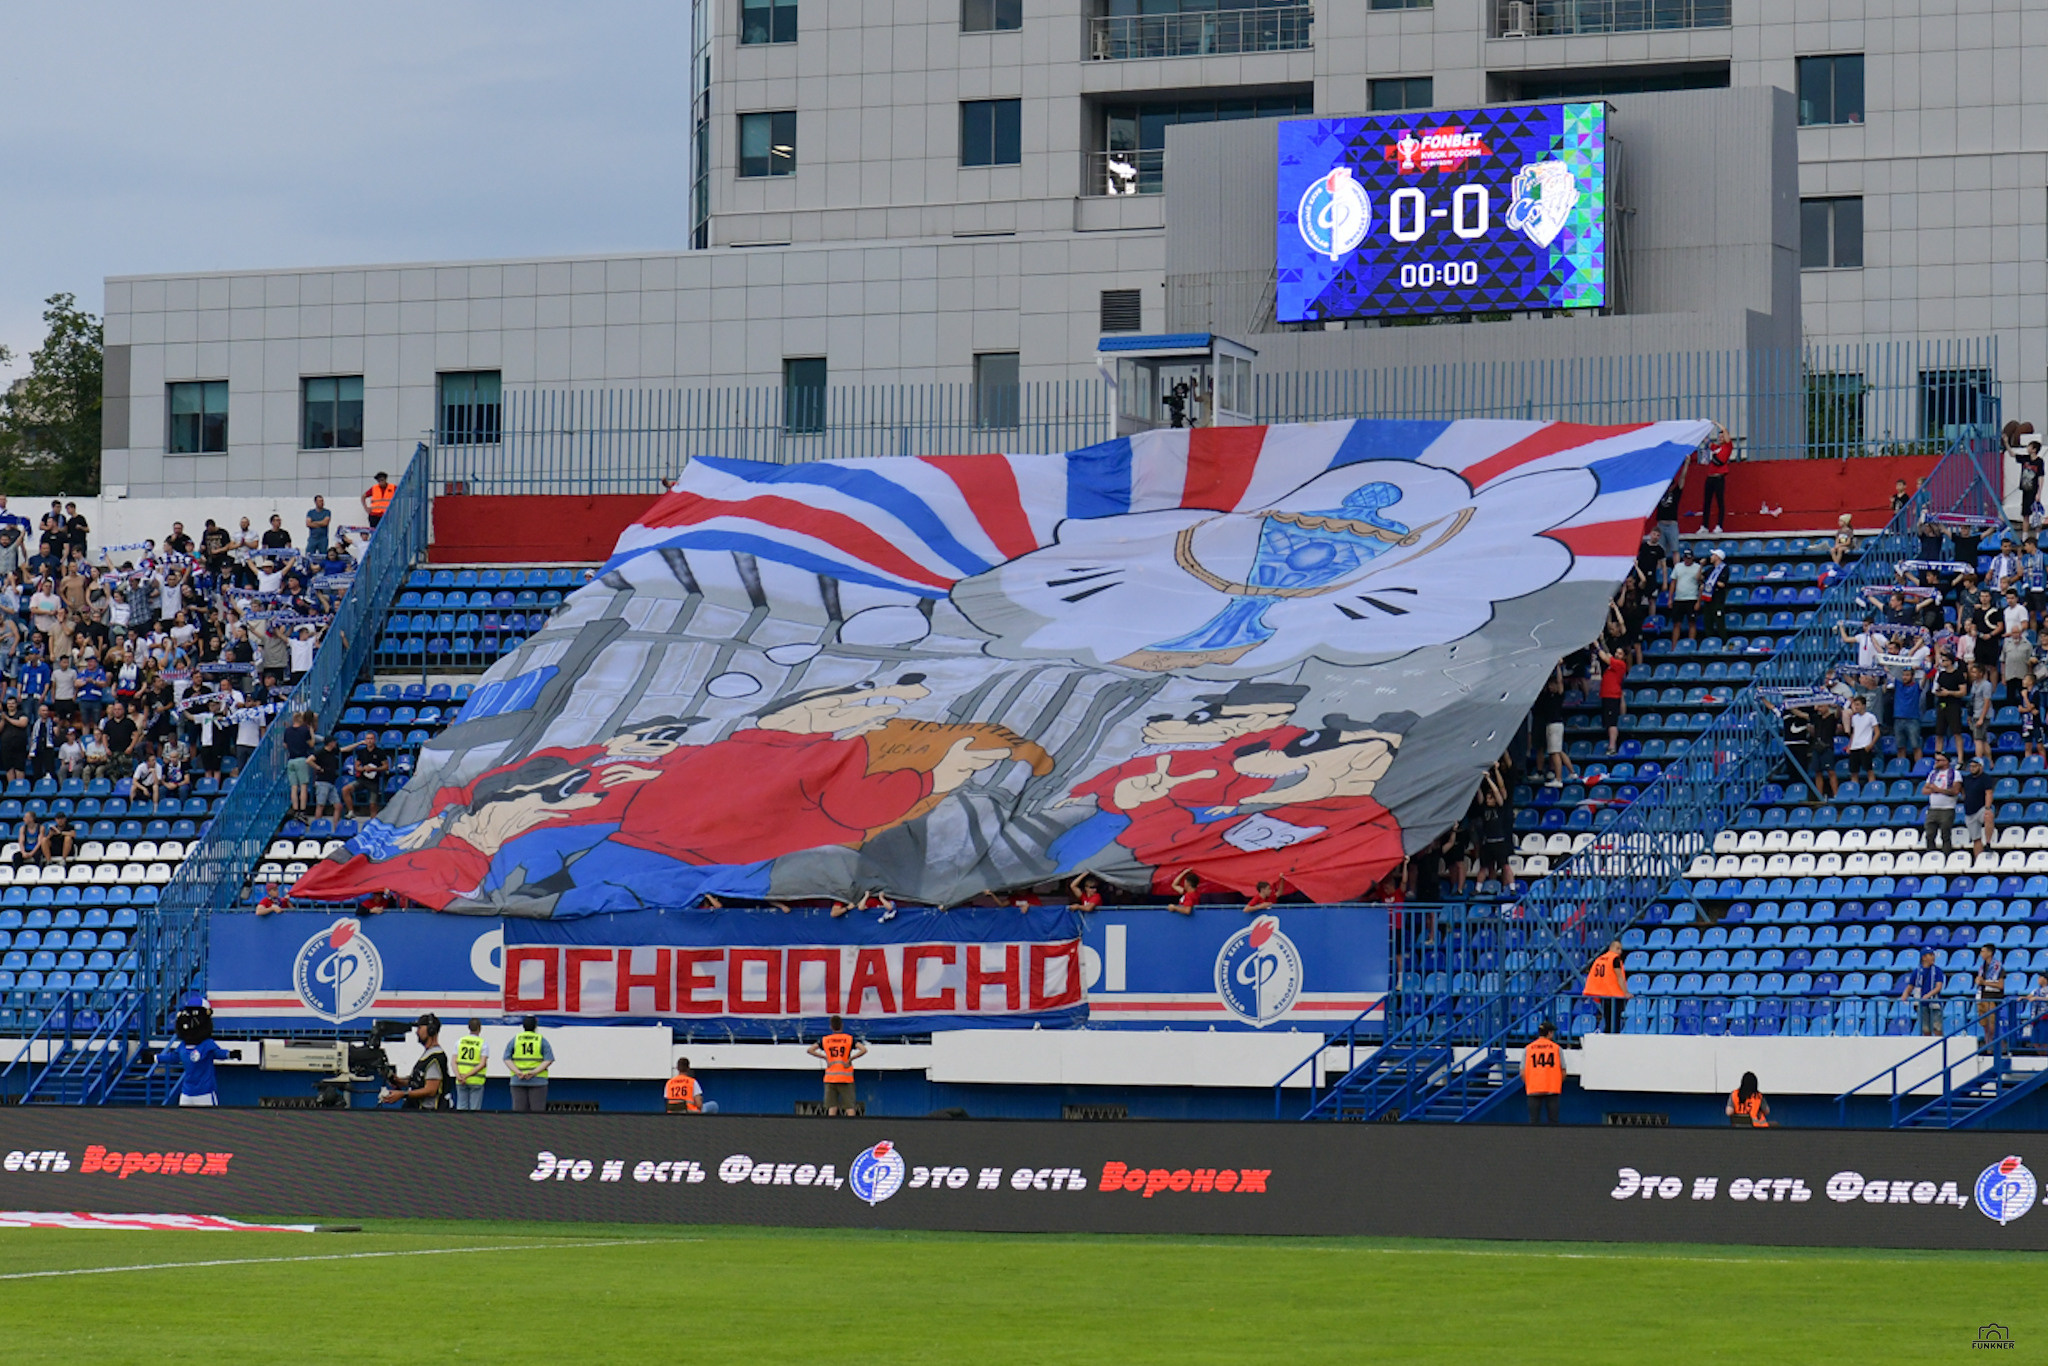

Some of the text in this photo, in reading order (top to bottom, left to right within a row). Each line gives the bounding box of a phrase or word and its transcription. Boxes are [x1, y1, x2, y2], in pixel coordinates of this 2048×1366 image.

[1421, 132, 1482, 149] FONBET
[1389, 184, 1489, 243] 0-0
[1401, 261, 1478, 288] 00:00
[504, 938, 1082, 1014] ОГНЕОПАСНО
[461, 1046, 475, 1060] 20
[521, 1042, 534, 1055] 14
[1531, 1052, 1555, 1068] 144
[671, 1086, 687, 1097] 126
[4, 1145, 234, 1179] есть Воронеж
[529, 1151, 593, 1181] Это
[600, 1159, 625, 1182] и
[633, 1160, 706, 1183] есть
[718, 1154, 844, 1190] Факел,
[908, 1166, 970, 1189] это
[976, 1168, 1003, 1190] и
[1010, 1168, 1088, 1191] есть
[1099, 1161, 1271, 1198] Воронеж
[1610, 1167, 1684, 1200] Это
[1691, 1177, 1718, 1201] и
[1729, 1177, 1813, 1203] есть
[1825, 1171, 1969, 1209] Факел,
